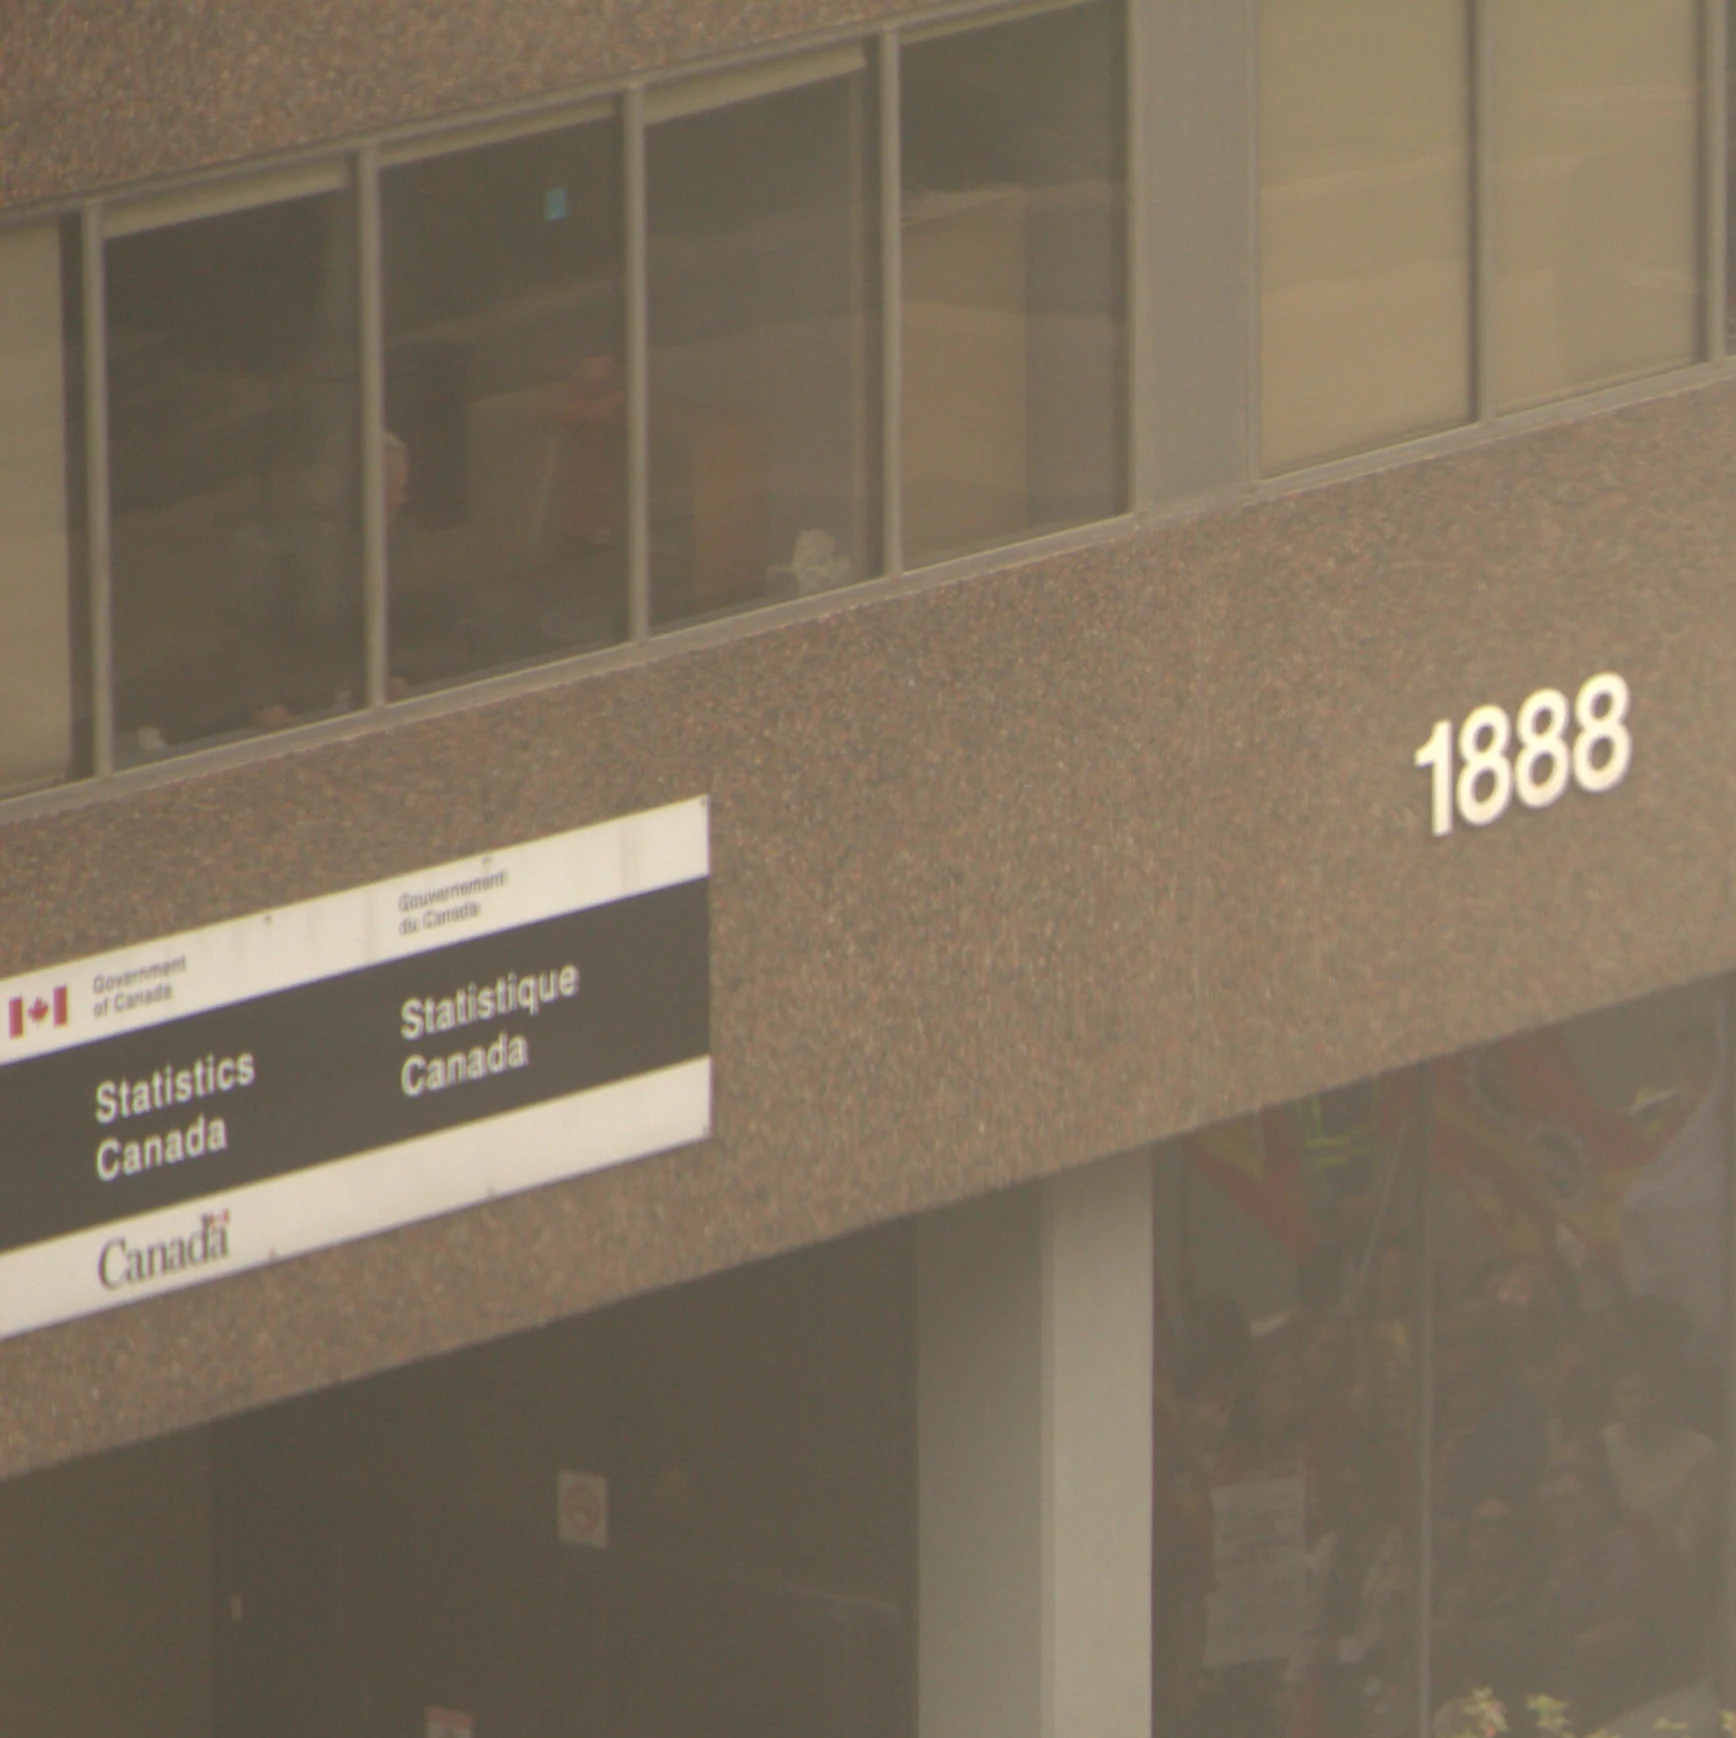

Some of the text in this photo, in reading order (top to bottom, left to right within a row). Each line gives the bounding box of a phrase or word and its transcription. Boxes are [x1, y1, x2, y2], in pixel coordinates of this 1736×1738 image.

[1414, 671, 1632, 837] 1888
[398, 869, 510, 914] Gouvernement
[398, 901, 481, 935] du Canada
[92, 955, 188, 996] Government
[92, 981, 173, 1018] of Canada
[400, 963, 580, 1041] Statistique
[95, 1049, 256, 1125] Statistics
[400, 1031, 530, 1097] Canada
[95, 1113, 228, 1182] Canada
[98, 1214, 230, 1292] Canada
